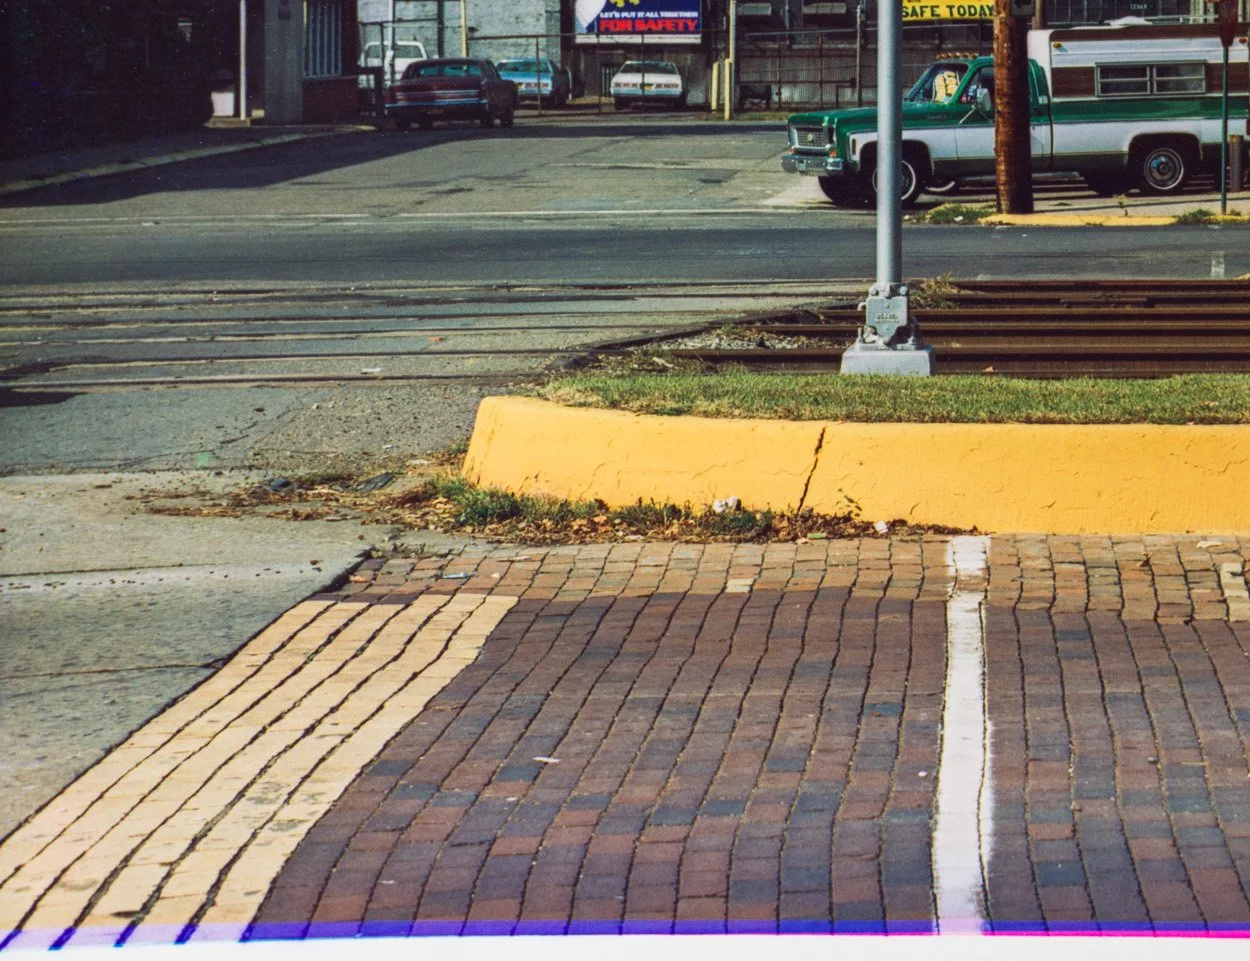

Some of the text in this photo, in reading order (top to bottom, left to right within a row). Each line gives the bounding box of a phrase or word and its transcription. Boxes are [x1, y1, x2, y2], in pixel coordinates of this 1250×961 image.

[902, 4, 994, 18] SAFE TODAY
[600, 19, 698, 32] FOR SAFETY
